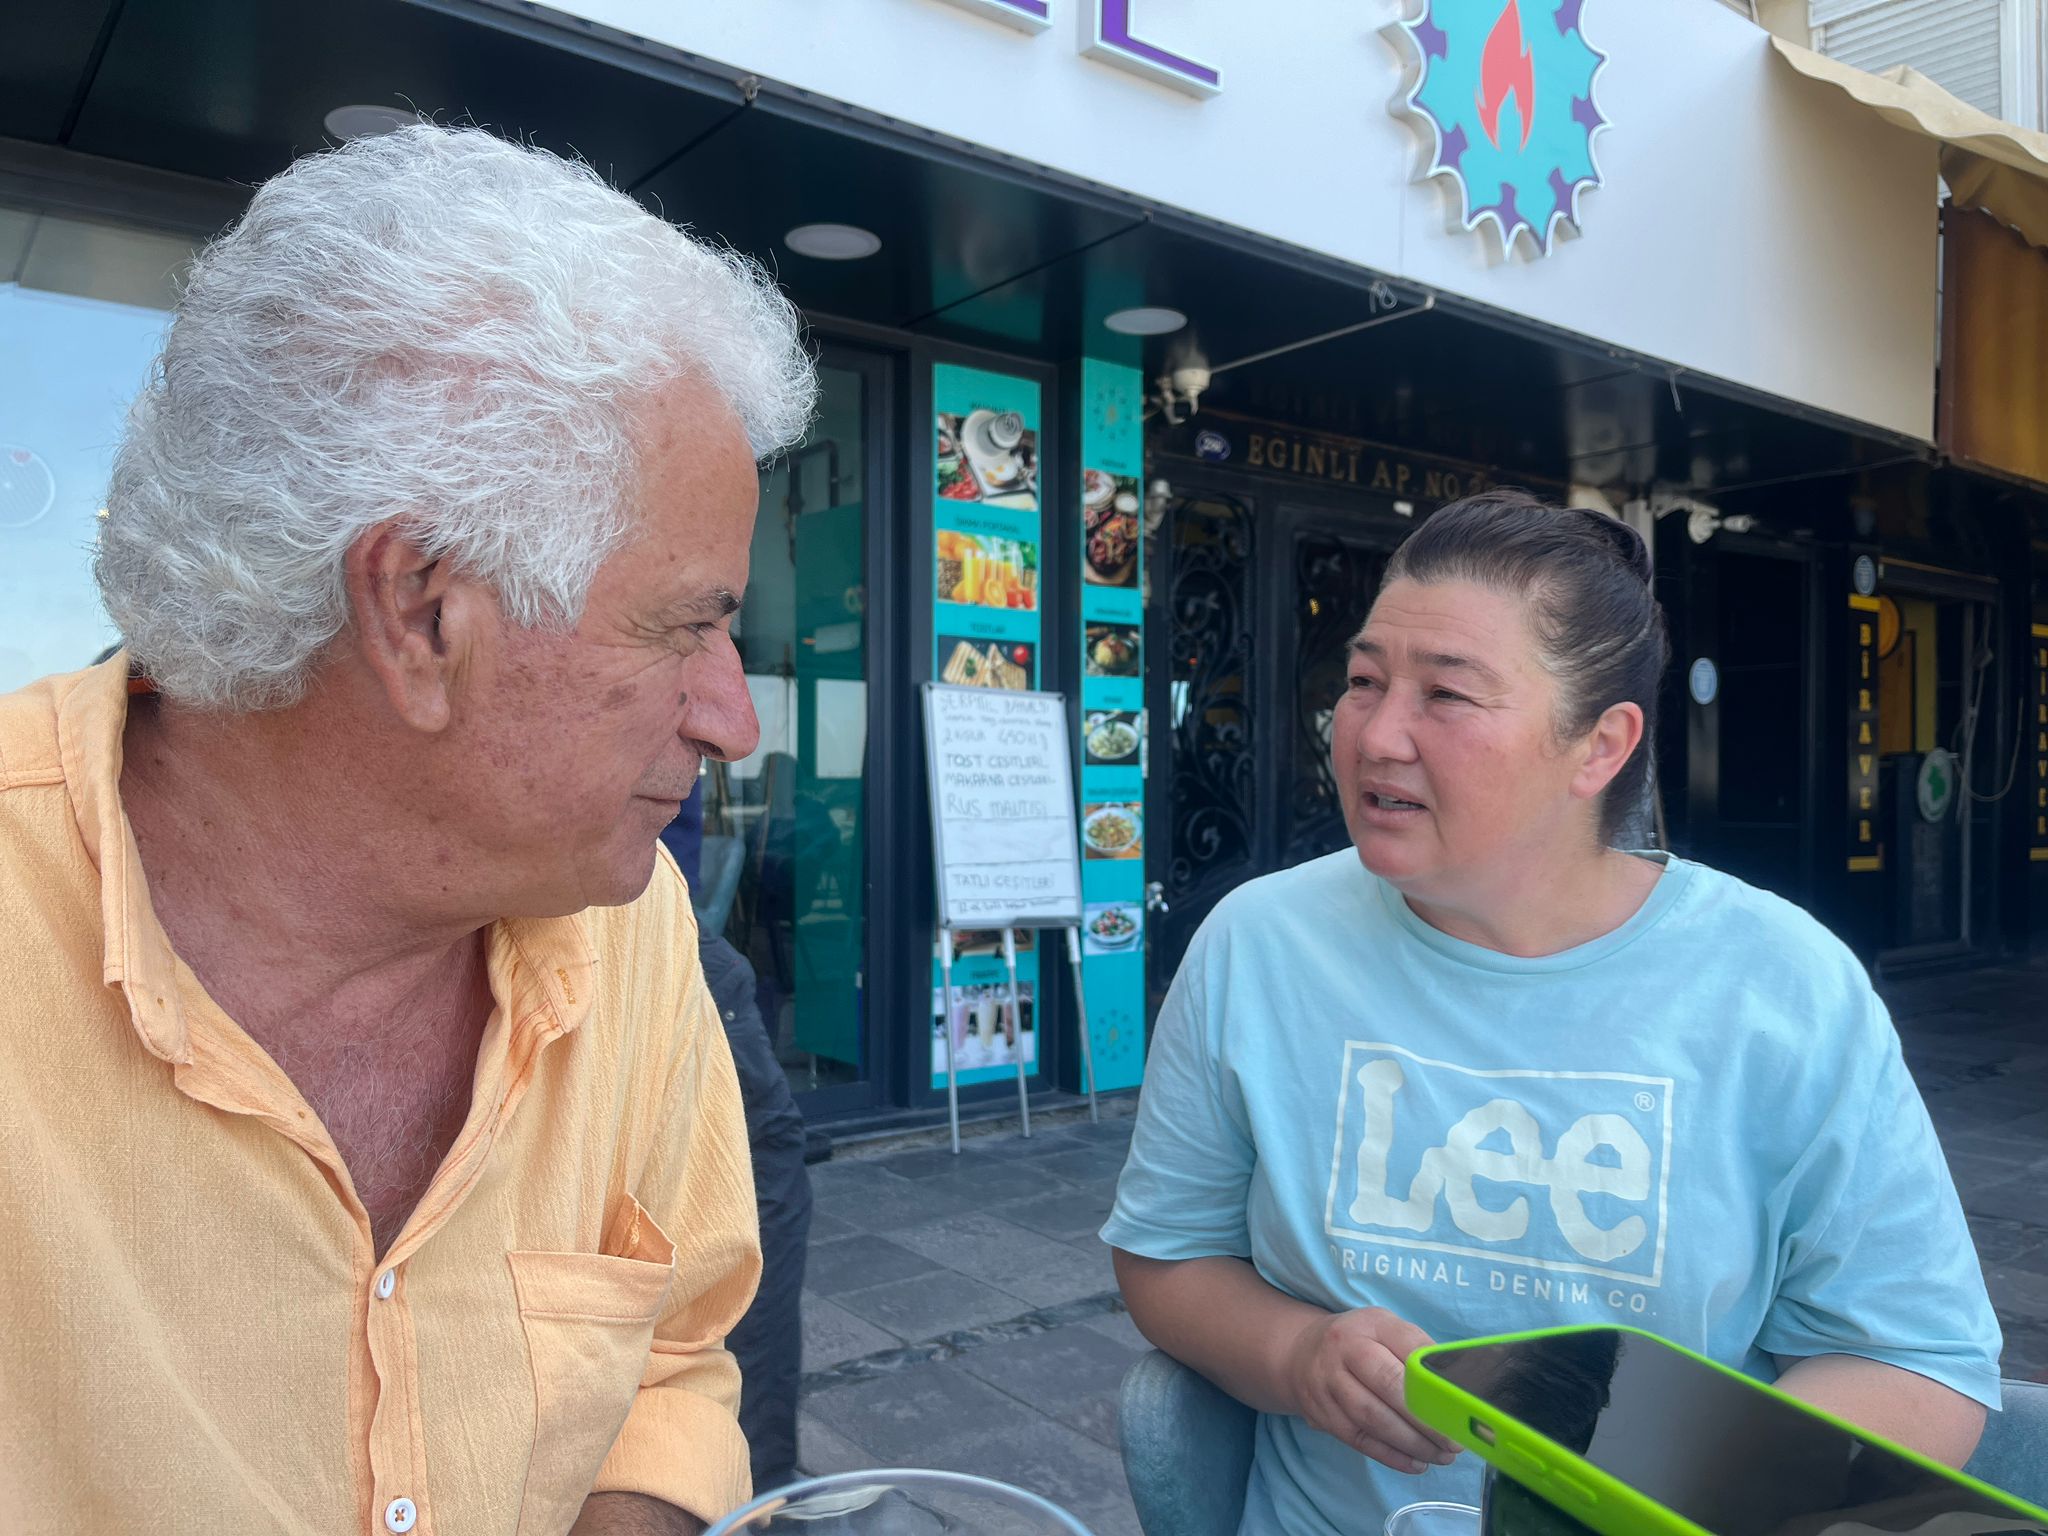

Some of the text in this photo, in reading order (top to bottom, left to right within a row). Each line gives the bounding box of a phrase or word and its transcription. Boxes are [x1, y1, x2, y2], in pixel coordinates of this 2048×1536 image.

[945, 754, 983, 768] TOST
[1350, 1059, 1650, 1262] Lee
[1490, 1270, 1589, 1305] DENIM
[1608, 1289, 1657, 1316] CO.
